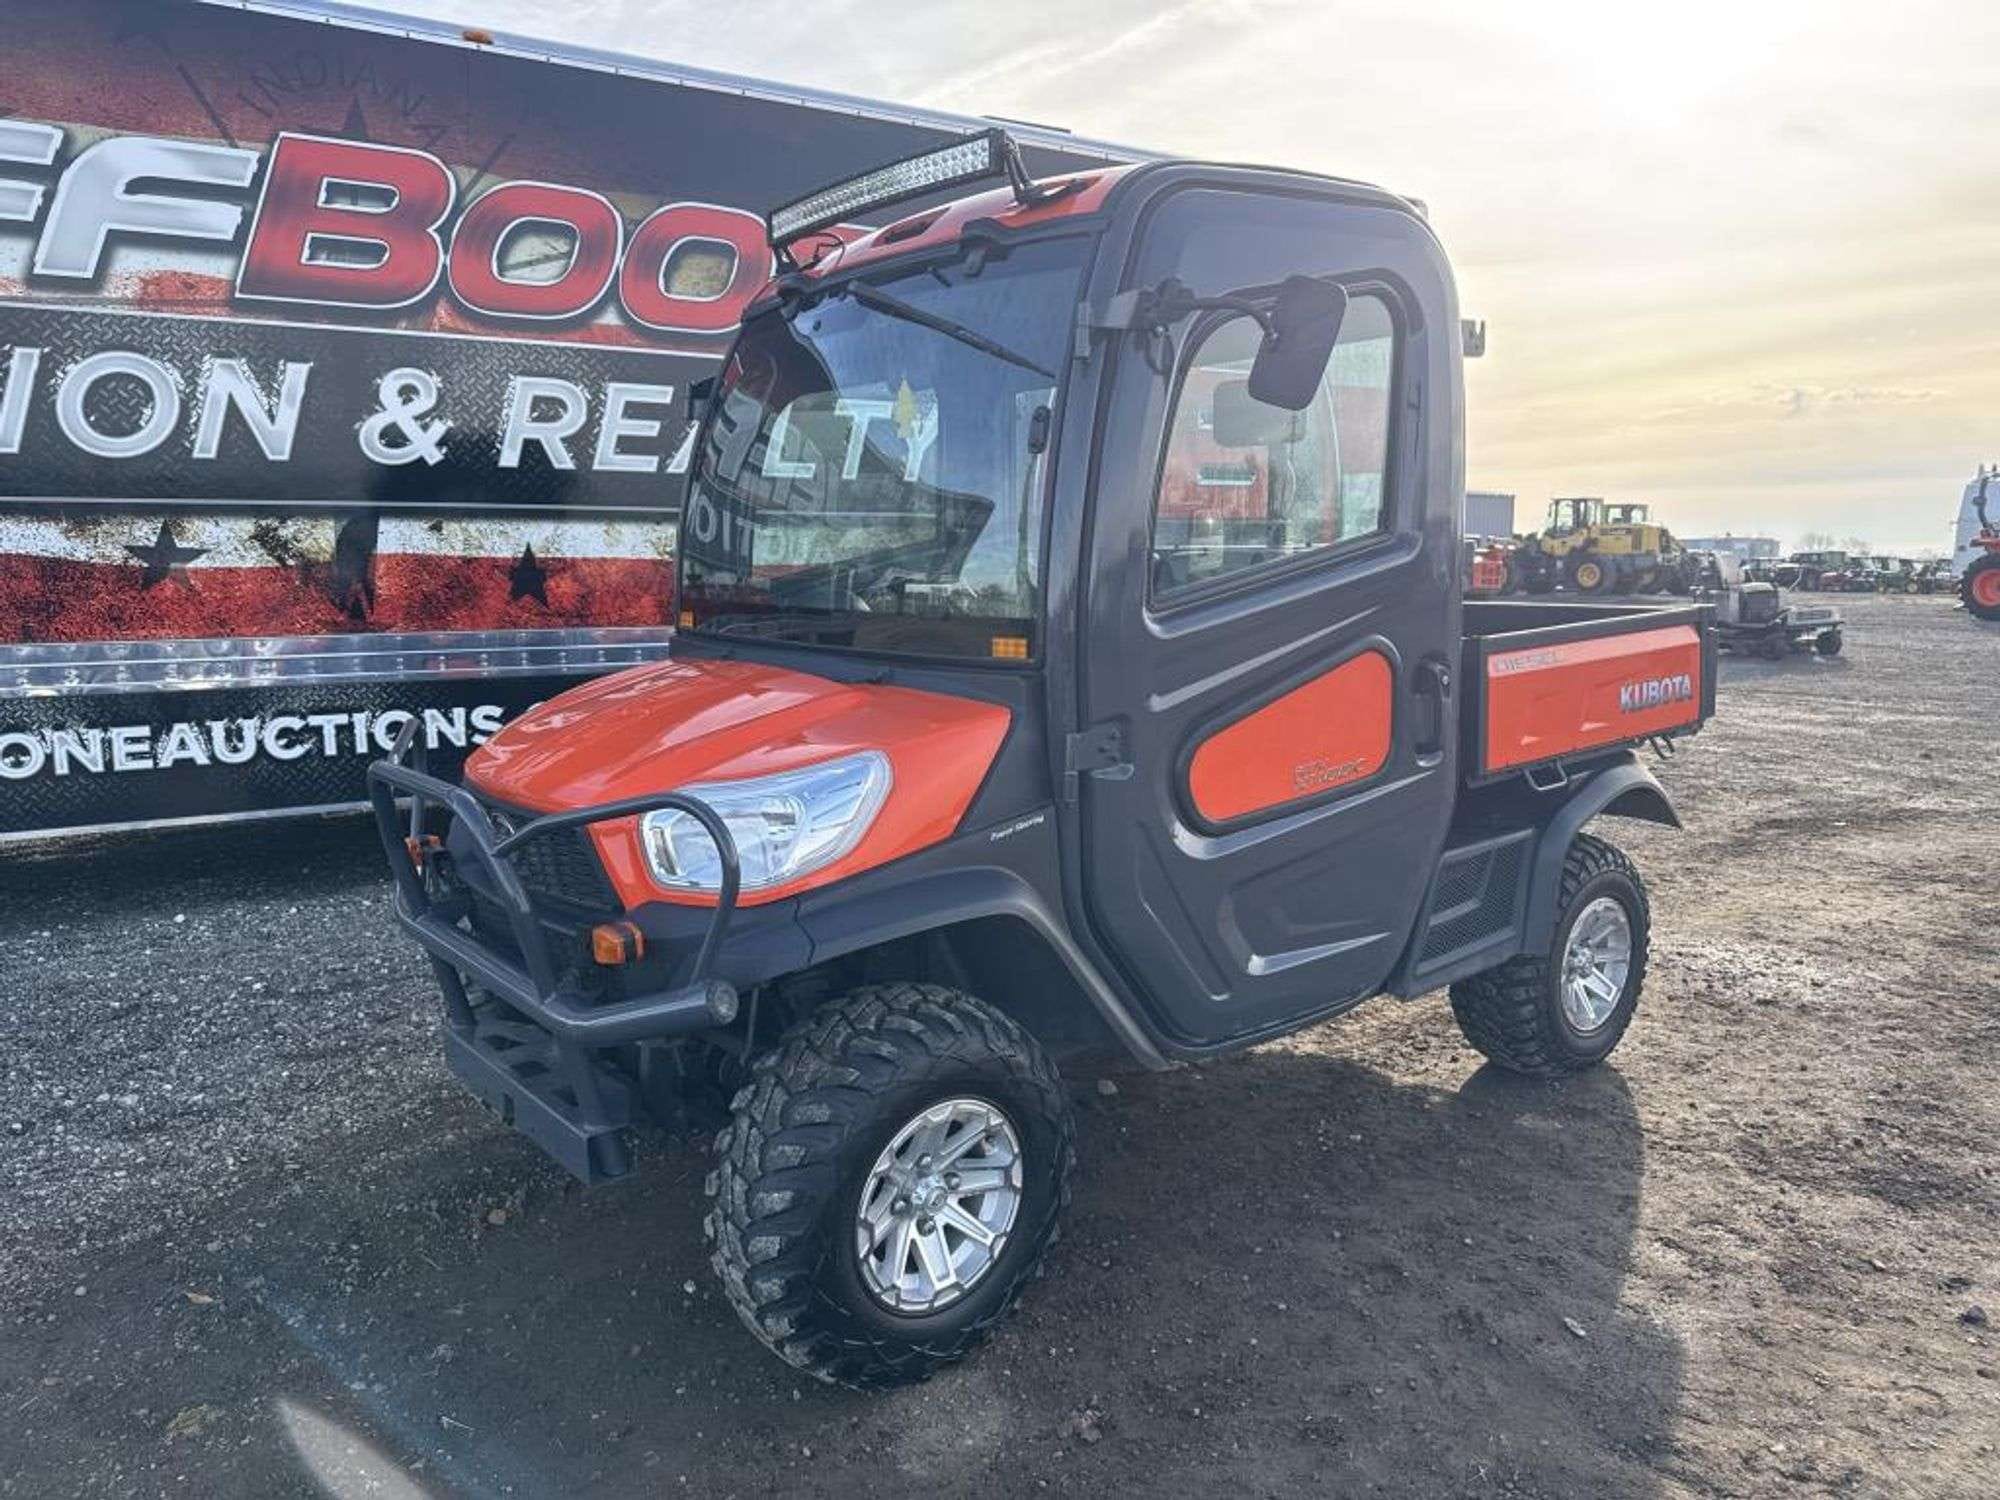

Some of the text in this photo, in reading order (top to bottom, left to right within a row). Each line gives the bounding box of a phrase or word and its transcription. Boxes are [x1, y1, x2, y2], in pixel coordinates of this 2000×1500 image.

[357, 366, 452, 467] &
[1620, 673, 1692, 711] KUBOTA
[0, 702, 545, 780] ONEAUCTIONS
